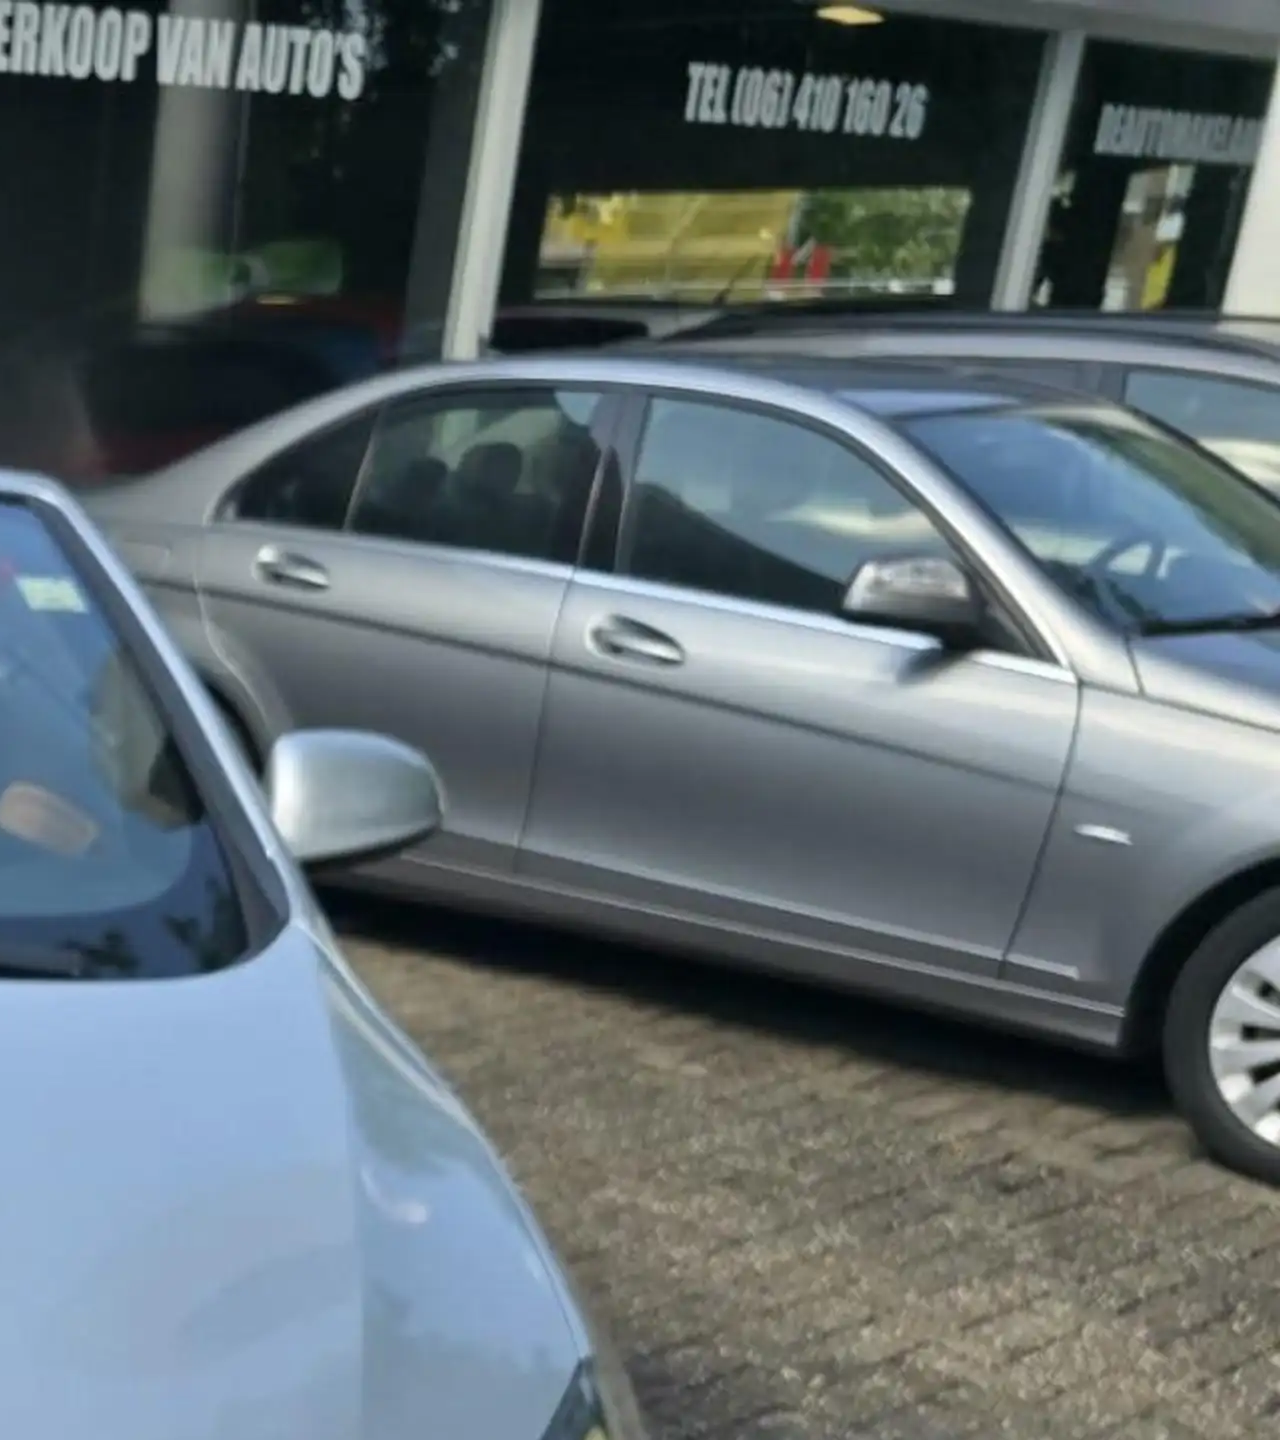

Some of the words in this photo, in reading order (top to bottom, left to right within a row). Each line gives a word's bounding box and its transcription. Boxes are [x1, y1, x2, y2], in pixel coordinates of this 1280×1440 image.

[156, 13, 236, 89] VAN
[235, 21, 366, 101] AUTO'S
[685, 61, 730, 124] TEL
[730, 65, 794, 128] (06)
[793, 72, 842, 133] 410
[889, 80, 930, 140] 26
